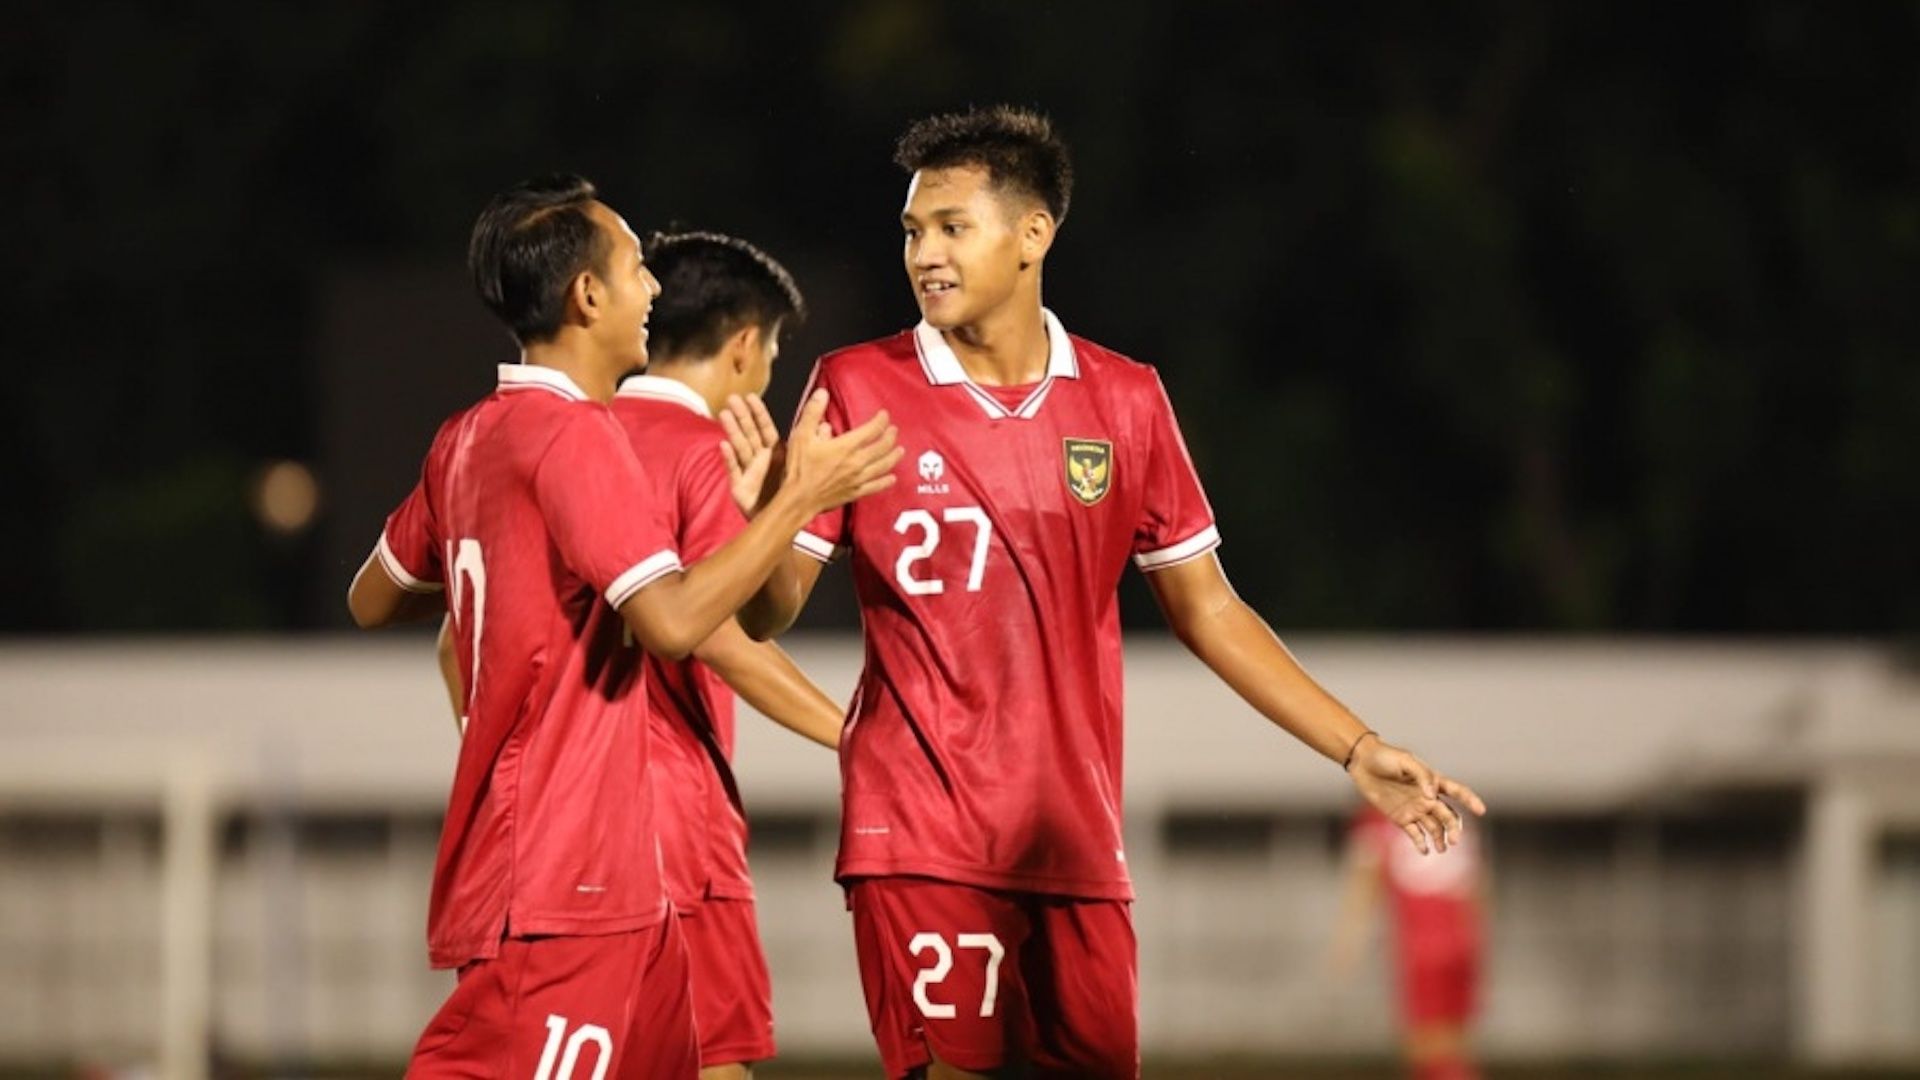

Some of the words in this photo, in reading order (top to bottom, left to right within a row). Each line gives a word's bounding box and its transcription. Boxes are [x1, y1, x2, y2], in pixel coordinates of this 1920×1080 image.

[894, 506, 992, 595] 27
[909, 932, 1004, 1018] 27
[534, 1014, 613, 1080] 10
